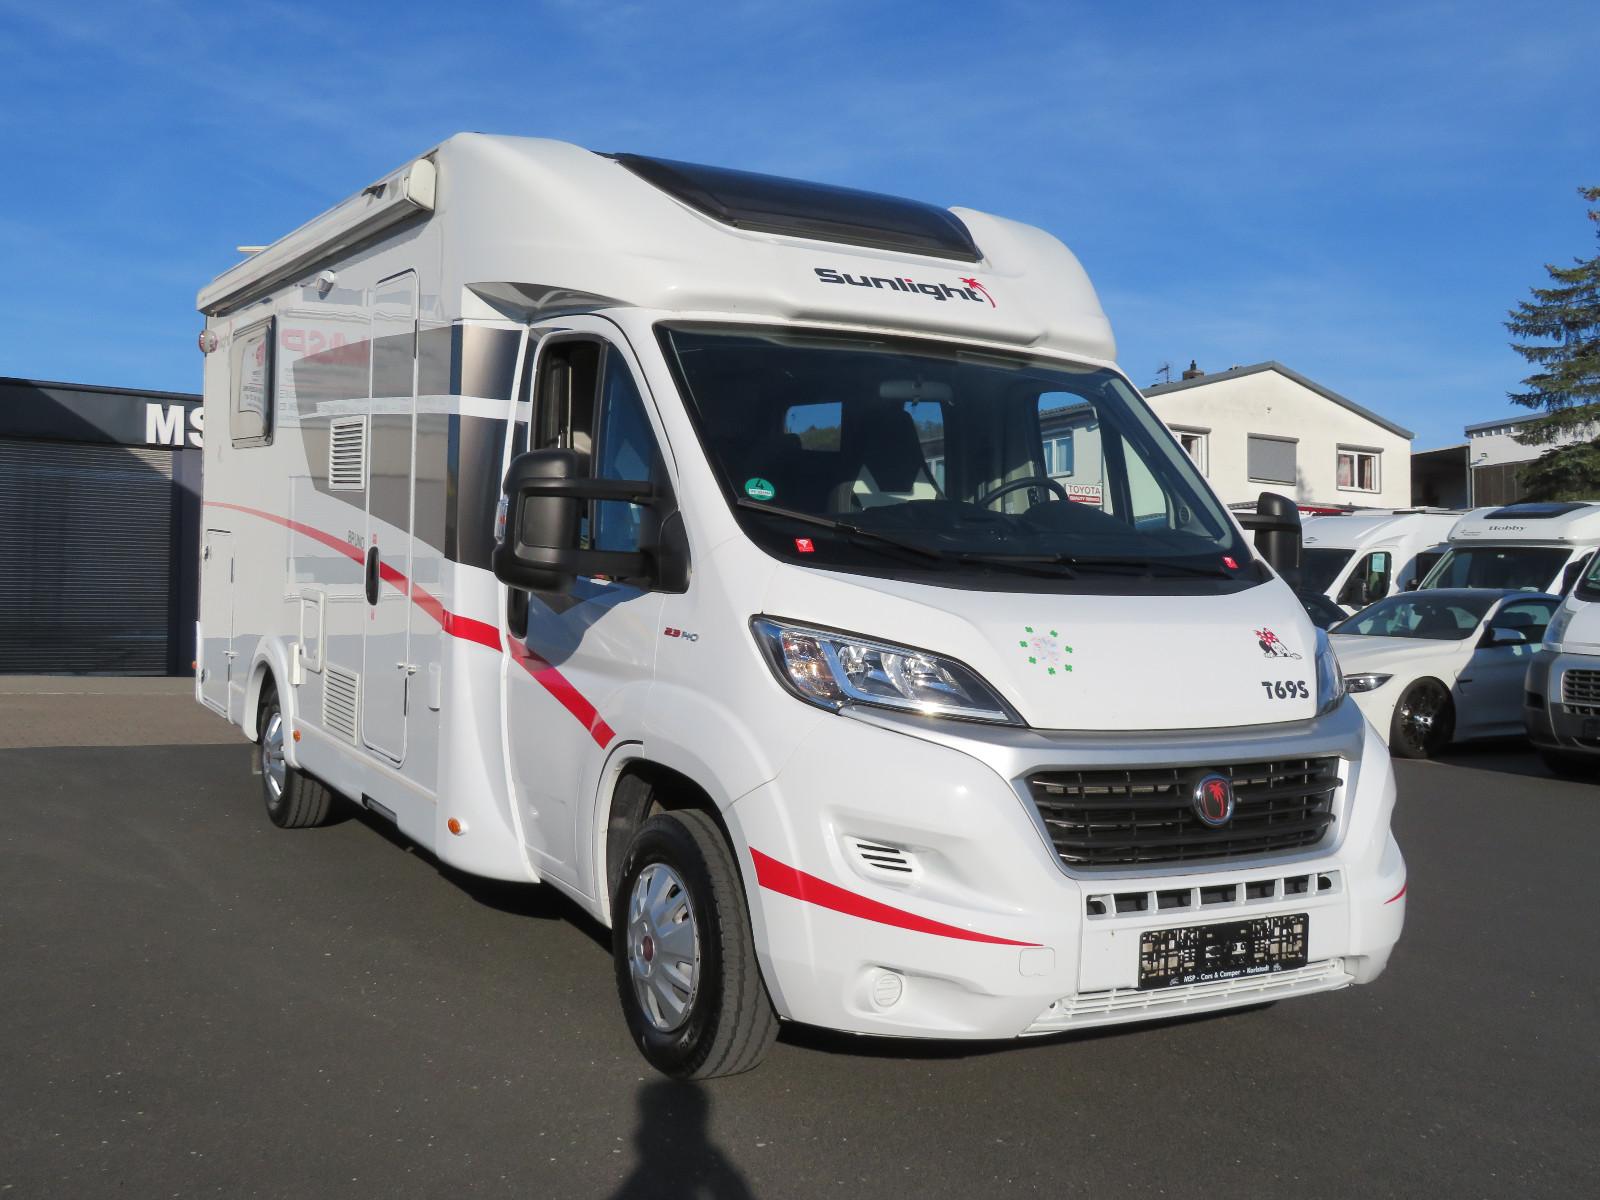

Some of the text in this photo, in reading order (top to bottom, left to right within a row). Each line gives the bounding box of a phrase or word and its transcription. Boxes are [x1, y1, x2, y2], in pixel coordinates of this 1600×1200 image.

[814, 268, 984, 301] Sunlight
[1068, 485, 1101, 495] TOYOTA
[1262, 680, 1309, 699] T69S
[1183, 974, 1196, 983] MSP
[1246, 964, 1270, 974] Karlstadt
